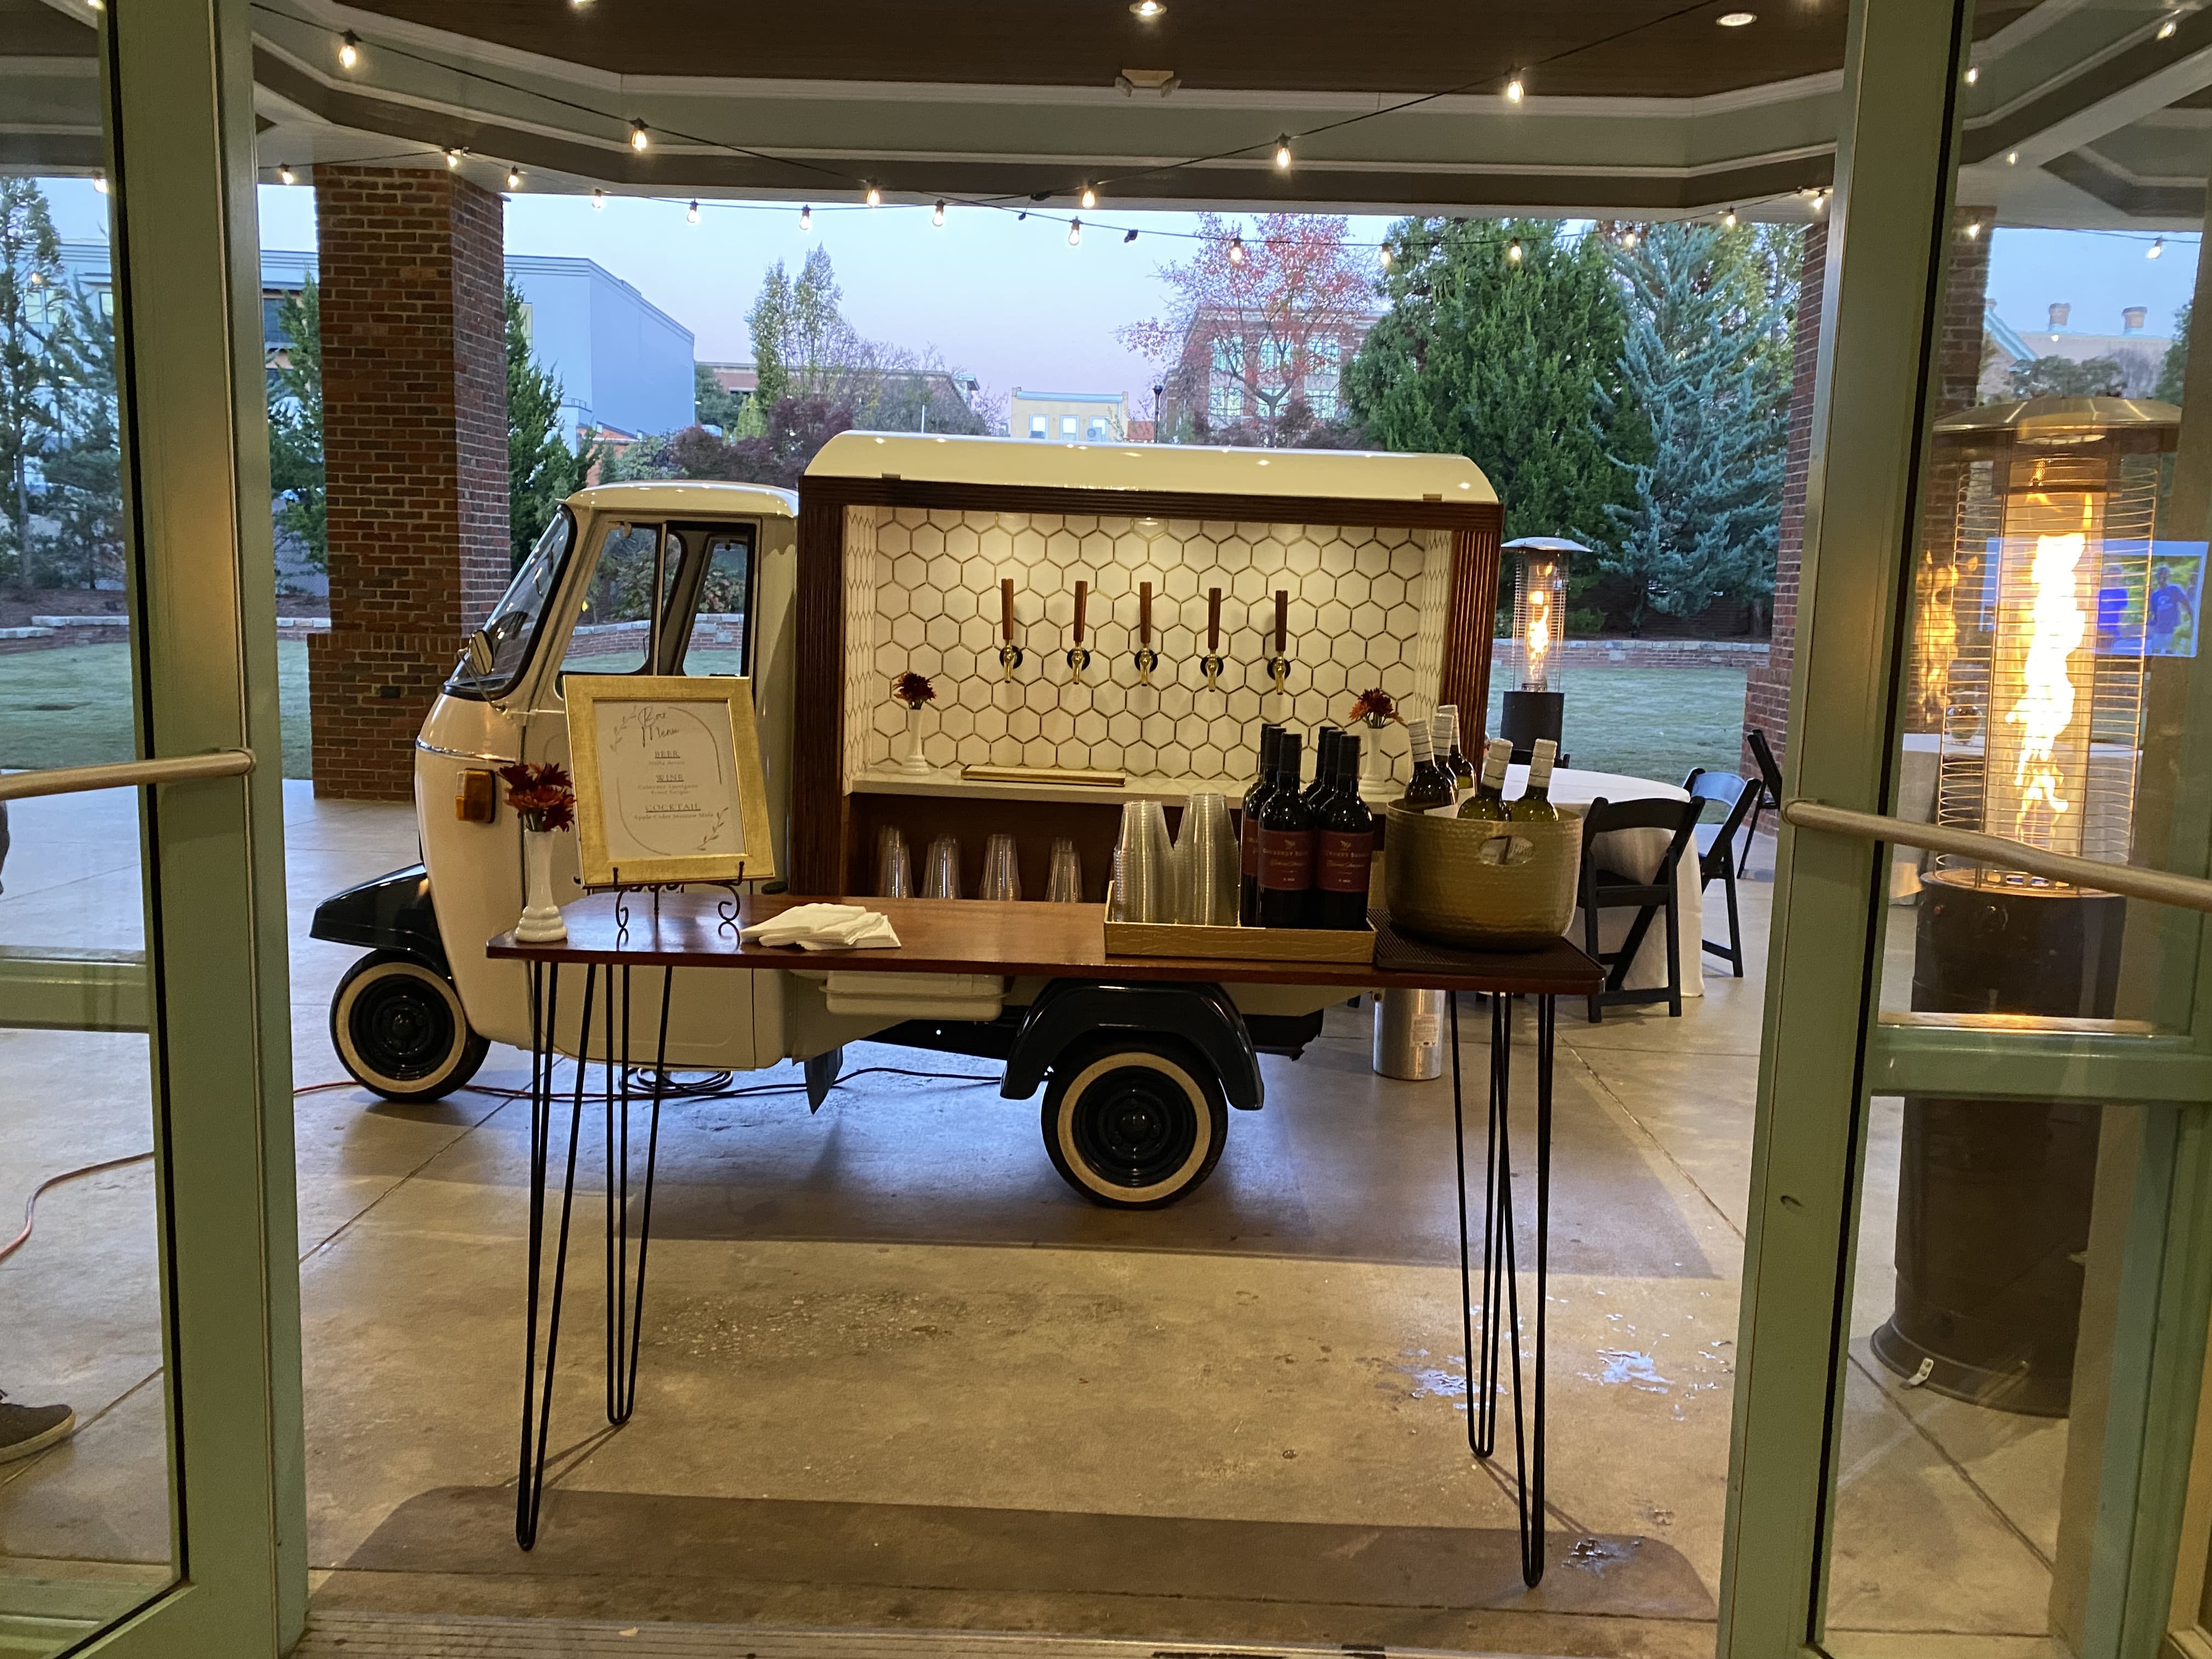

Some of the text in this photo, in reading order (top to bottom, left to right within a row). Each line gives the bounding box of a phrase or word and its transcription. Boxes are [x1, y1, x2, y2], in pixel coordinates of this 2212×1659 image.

[654, 751, 680, 759] BEER
[656, 774, 685, 782] WINE
[645, 803, 701, 813] COCKTAIL
